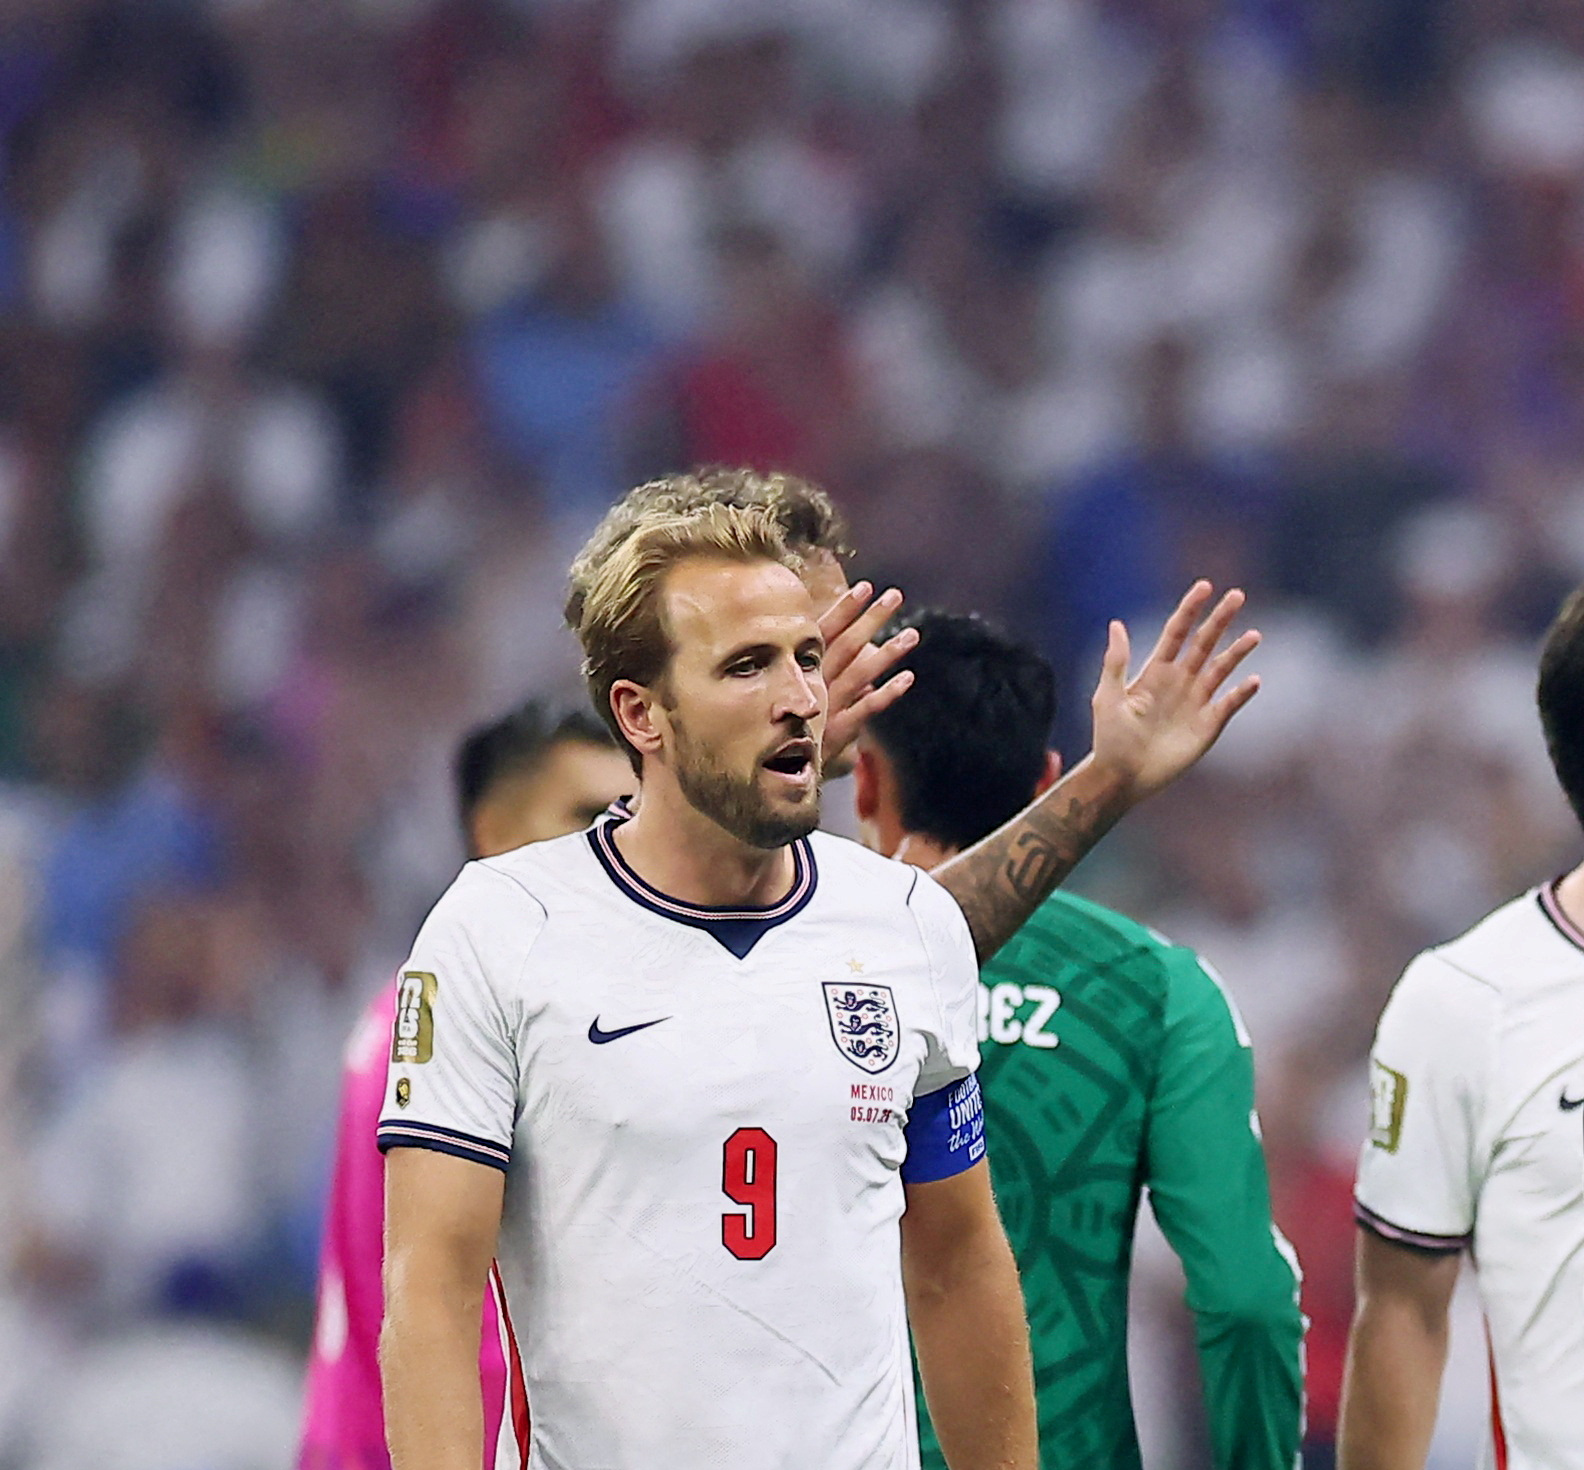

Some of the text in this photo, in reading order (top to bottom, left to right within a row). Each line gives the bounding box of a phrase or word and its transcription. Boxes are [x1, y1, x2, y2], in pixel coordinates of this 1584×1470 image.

[979, 981, 1062, 1049] EZ
[851, 1084, 894, 1102] MEXICO
[722, 1127, 777, 1261] 9
